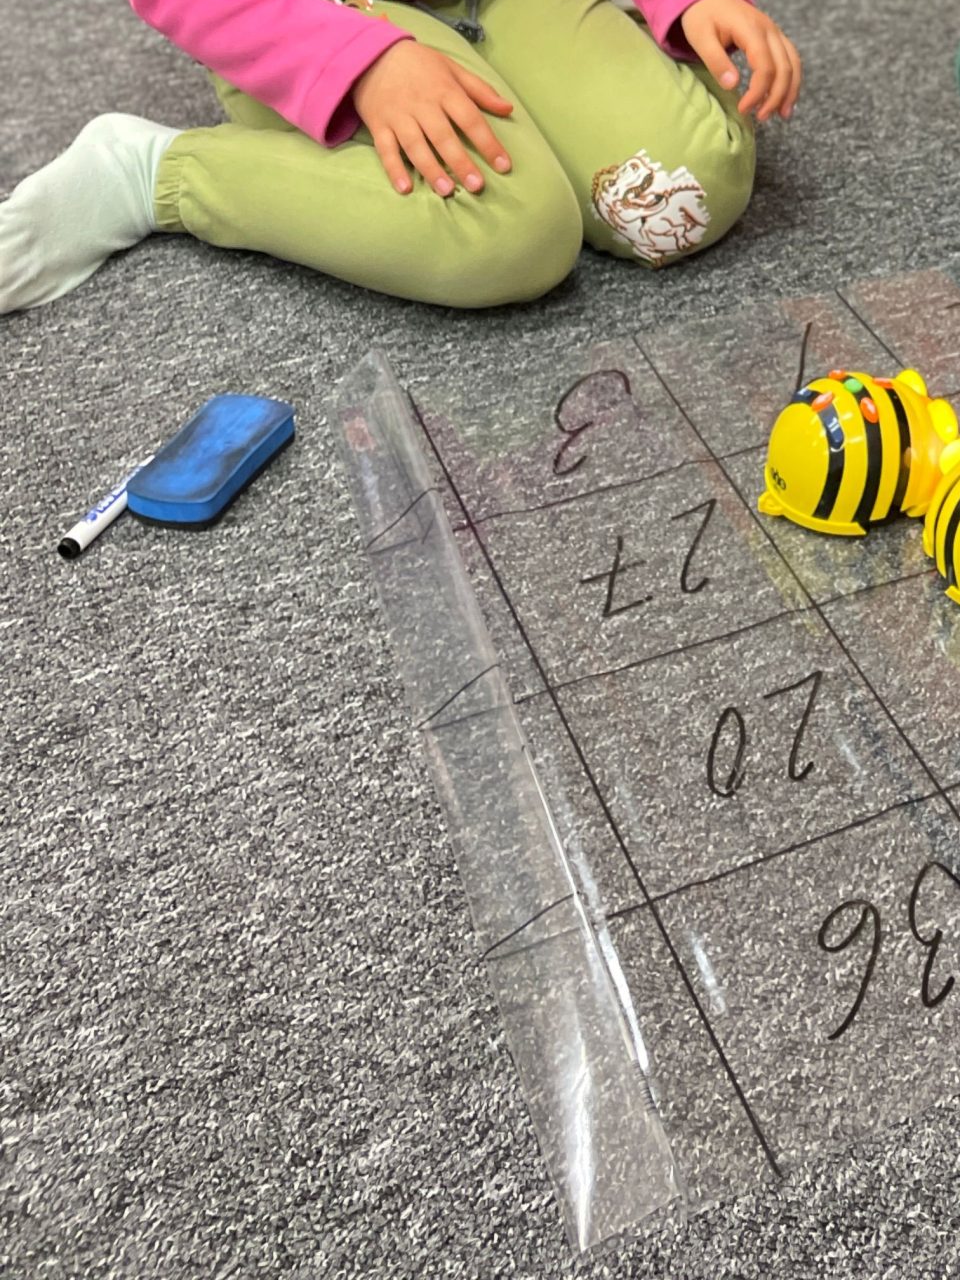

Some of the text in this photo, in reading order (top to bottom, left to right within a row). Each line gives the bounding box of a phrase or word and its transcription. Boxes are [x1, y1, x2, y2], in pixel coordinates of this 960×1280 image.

[553, 368, 632, 475] 3
[580, 498, 717, 618] 27
[706, 669, 823, 798] 20
